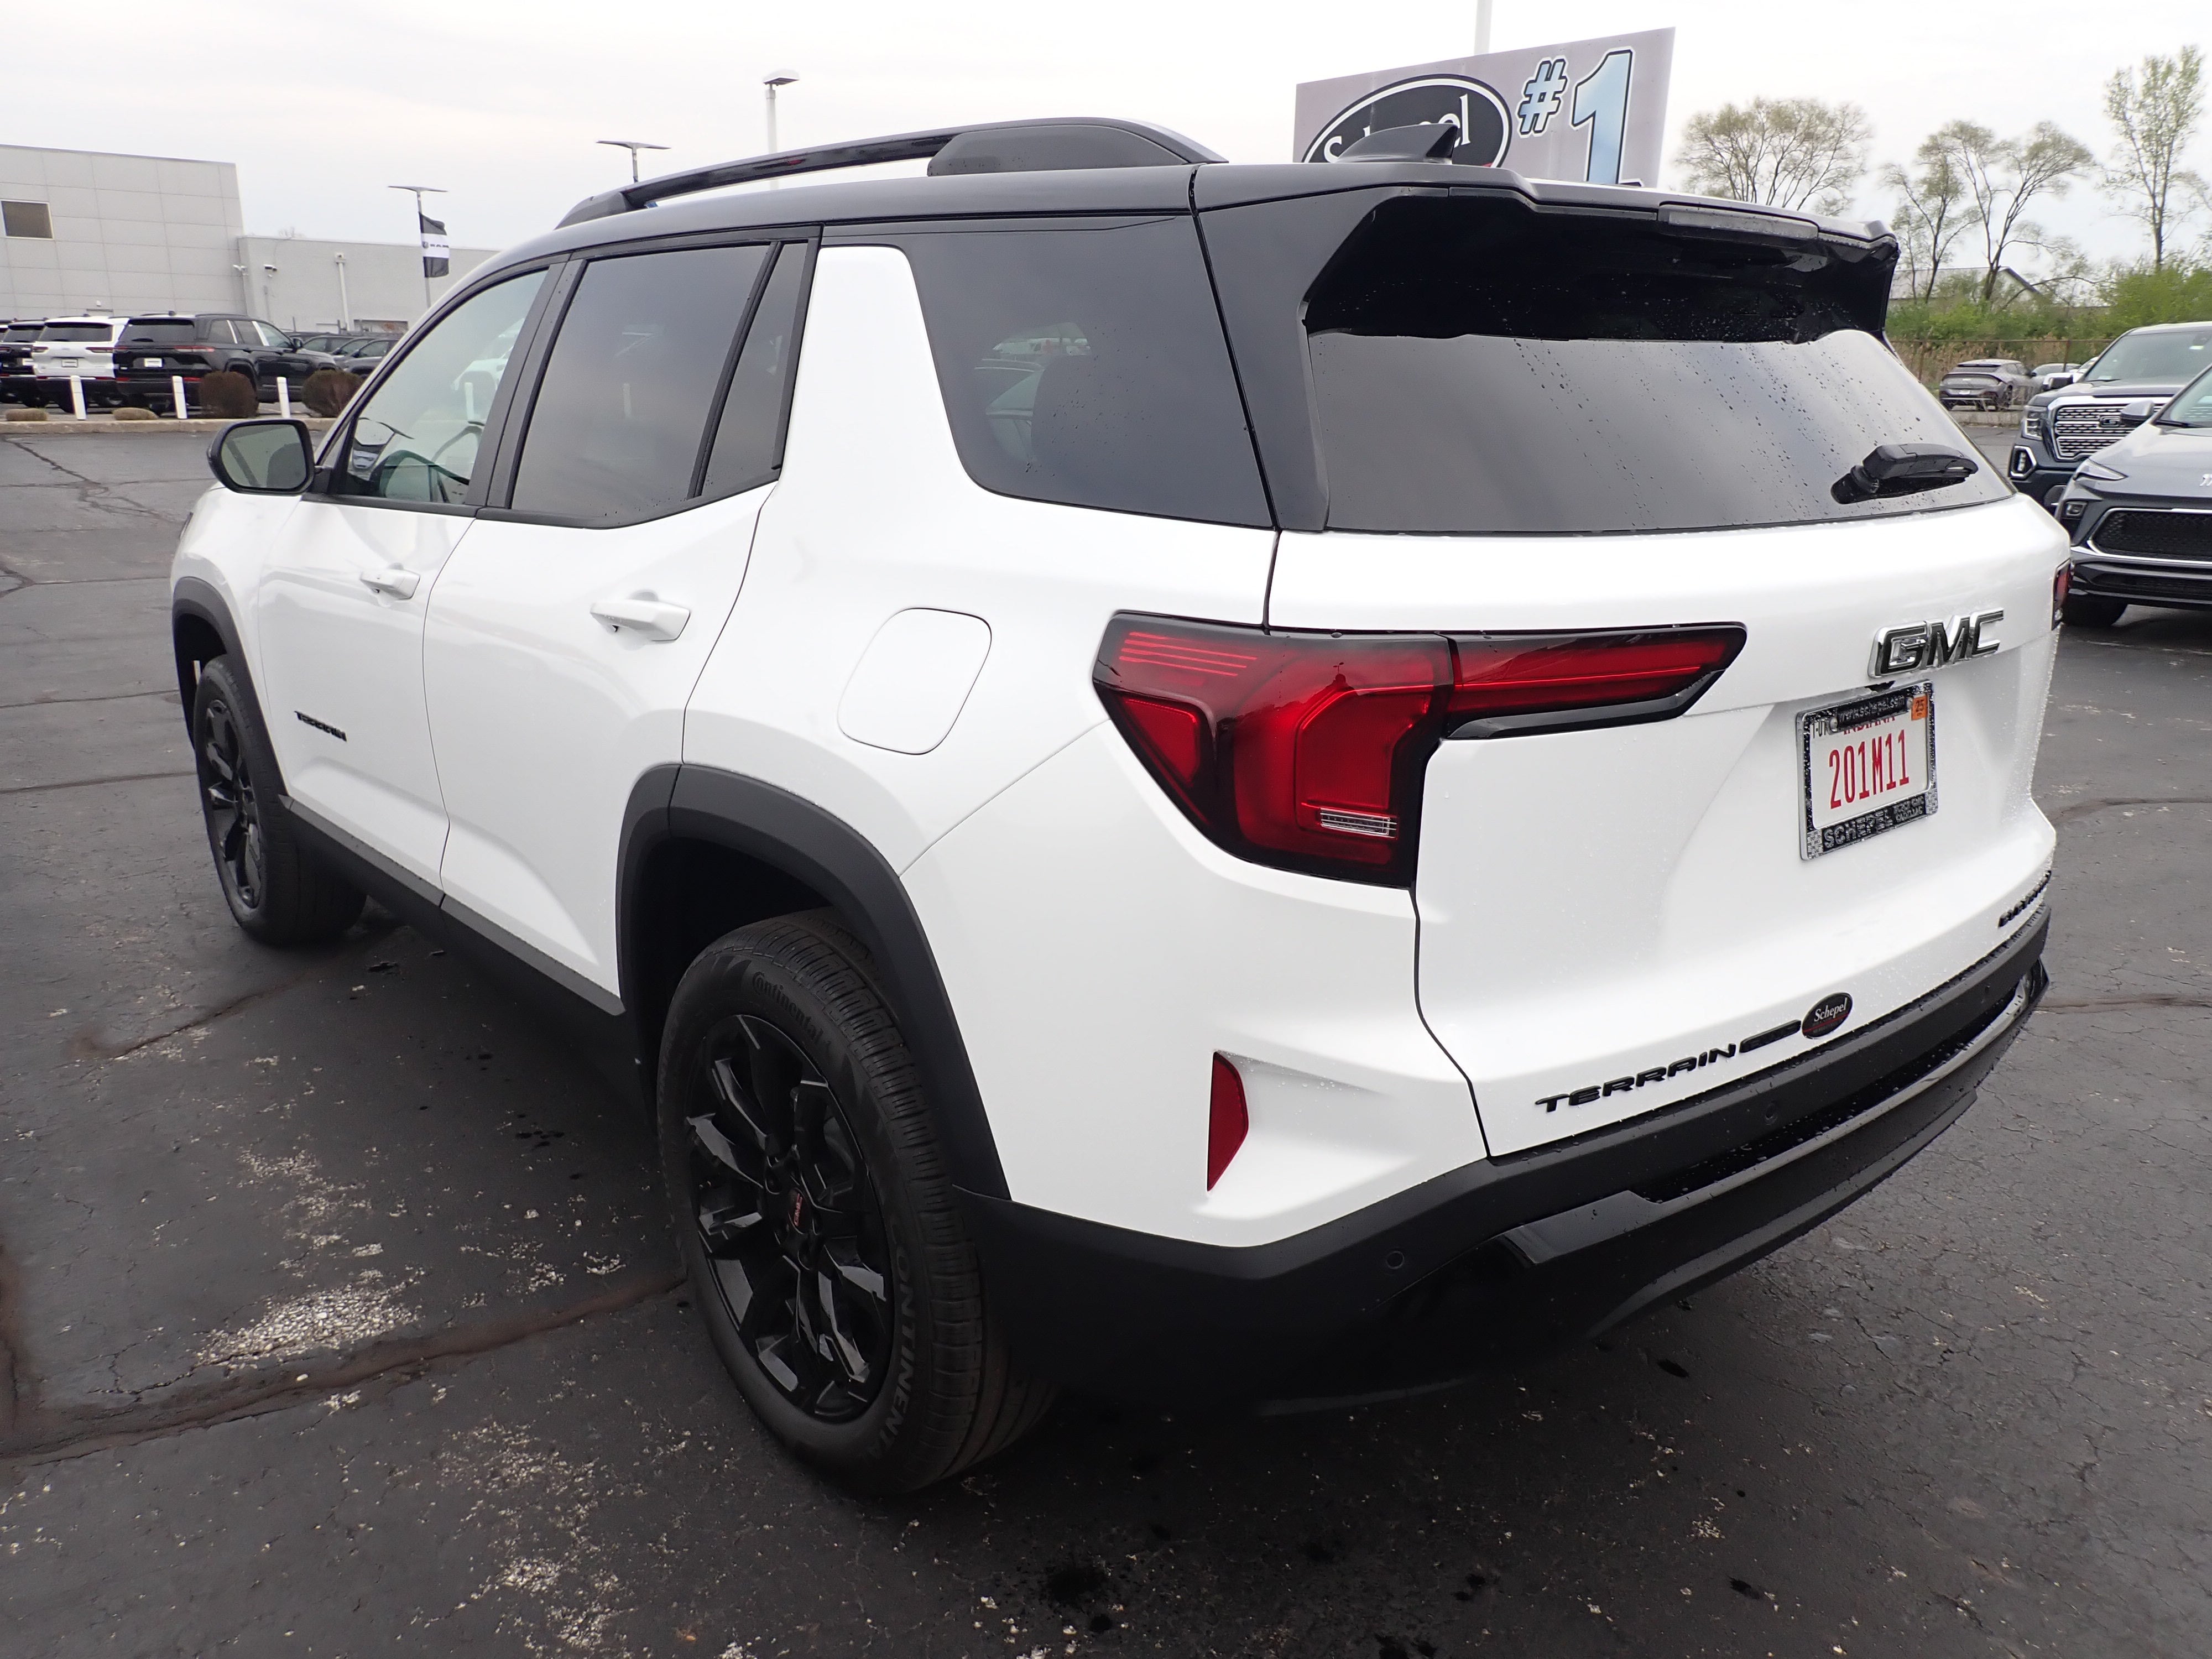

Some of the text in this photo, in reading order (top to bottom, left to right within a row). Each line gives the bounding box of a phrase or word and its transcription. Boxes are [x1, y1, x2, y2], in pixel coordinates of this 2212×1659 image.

[1517, 48, 1642, 186] #1
[1867, 607, 2004, 678] GMC
[1915, 699, 1924, 712] 25
[1829, 729, 1910, 810] 201M11
[1824, 809, 1893, 849] SCHEPEL
[1813, 997, 1848, 1022] Schepel
[1535, 1042, 1736, 1113] TERRAIN
